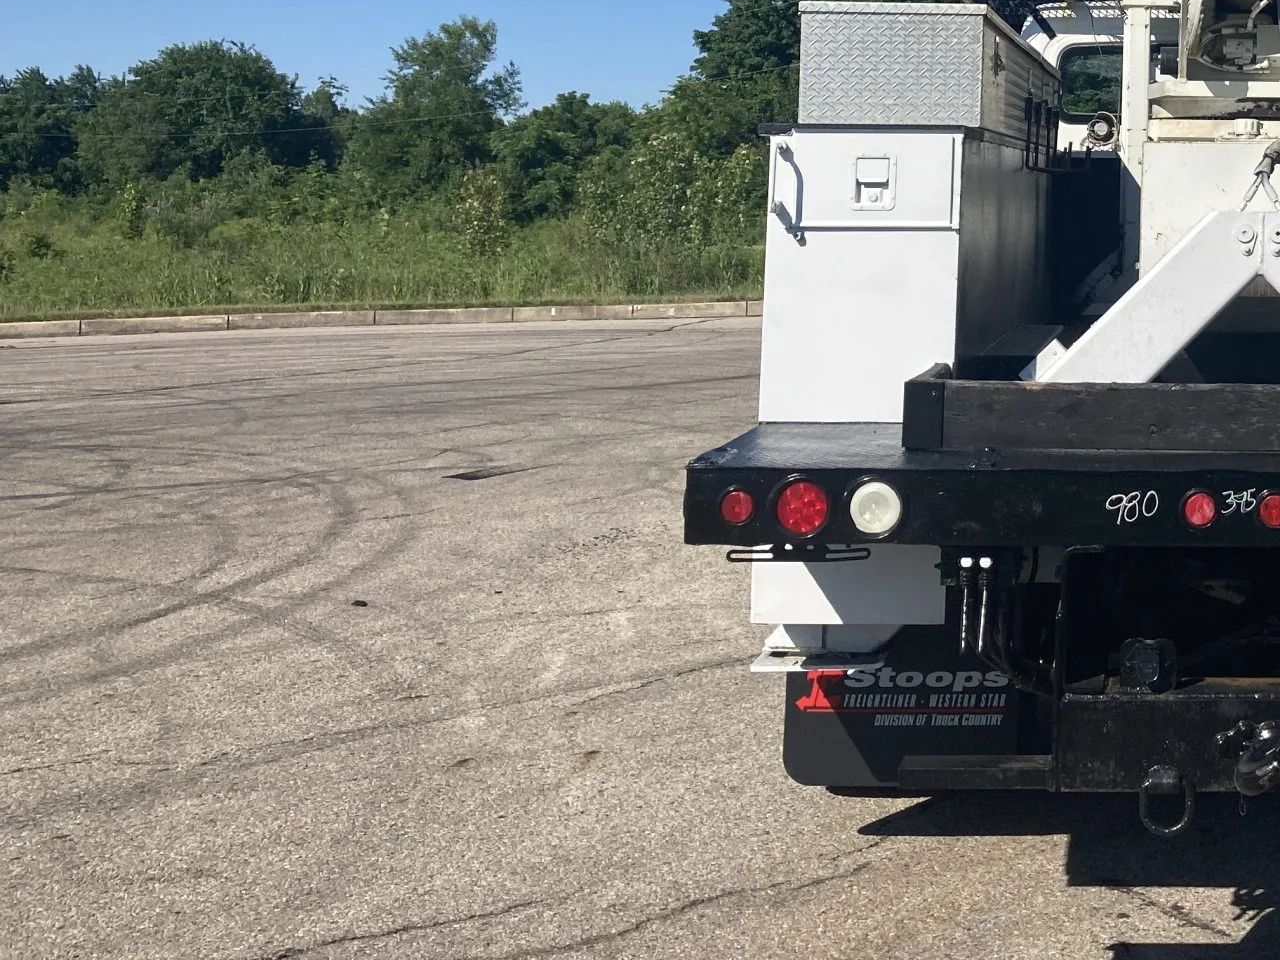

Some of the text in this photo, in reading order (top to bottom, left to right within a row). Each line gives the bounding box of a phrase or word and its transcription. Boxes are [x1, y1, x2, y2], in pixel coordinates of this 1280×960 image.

[1105, 490, 1159, 525] 980
[843, 666, 1009, 692] Stoops
[843, 693, 1006, 708] FREIGHTLINER WESTERN STAR
[874, 713, 1003, 726] DIVISION OF TRUCK COUNTRY
